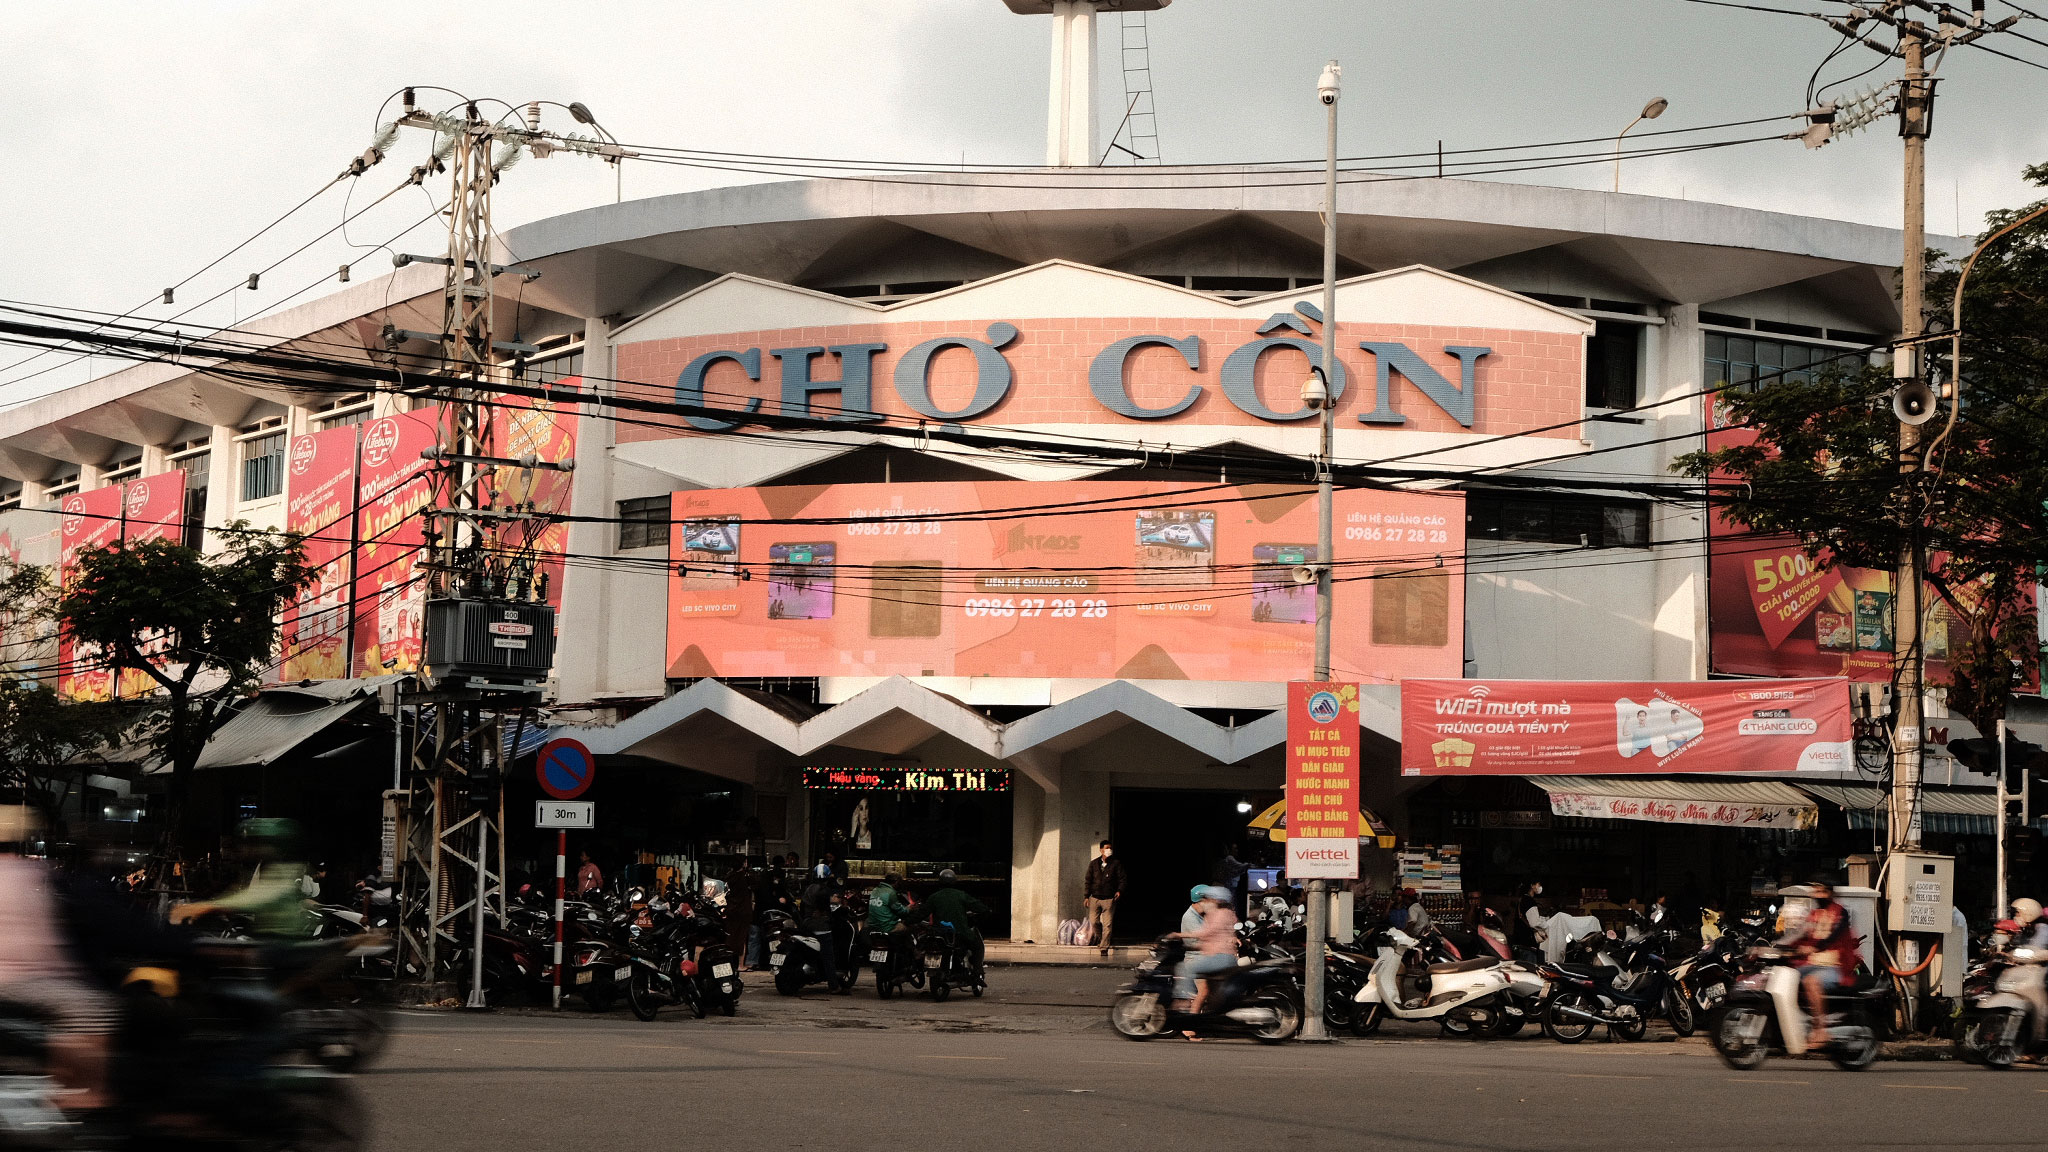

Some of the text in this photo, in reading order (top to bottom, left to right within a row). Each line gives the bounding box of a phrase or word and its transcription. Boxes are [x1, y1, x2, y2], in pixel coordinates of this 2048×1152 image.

[674, 301, 1490, 436] CHỢ CỒN
[366, 436, 394, 449] Lifebuoy
[1347, 512, 1446, 526] LIÊN HỆ QUẢNG CÁO
[848, 522, 941, 536] 0986 27 28 28
[1345, 526, 1447, 543] 0986 27 28 28
[984, 576, 1088, 589] LIÊN HỆ QUẢNG CÁO
[1759, 594, 1782, 613] GIẢI
[1782, 577, 1810, 600] KHUYẾN
[965, 598, 1108, 618] 0986 27 28 28
[1435, 698, 1571, 718] WiFi mượt mà
[1436, 720, 1483, 734] TRÚNG
[1486, 720, 1515, 734] QUÀ
[1518, 719, 1548, 734] TIỀN
[1751, 721, 1786, 731] THÁNG
[1787, 720, 1814, 731] CƯỚC
[1309, 728, 1340, 740] TẤT CẢ
[1296, 745, 1350, 758] VÌ MỤC TIÊU
[1808, 752, 1843, 760] viettel
[1302, 761, 1344, 772] DÂN GIÀU
[829, 772, 986, 789] Hiệu vàng Kim Thi
[1296, 777, 1350, 790] NƯỚC MẠNH
[1303, 793, 1342, 805] DÂN CHỦ
[554, 809, 576, 819] 30m
[1297, 808, 1348, 821] CÔNG BẰNG
[1300, 826, 1344, 837] VĂN MINH
[1296, 849, 1350, 860] viettel
